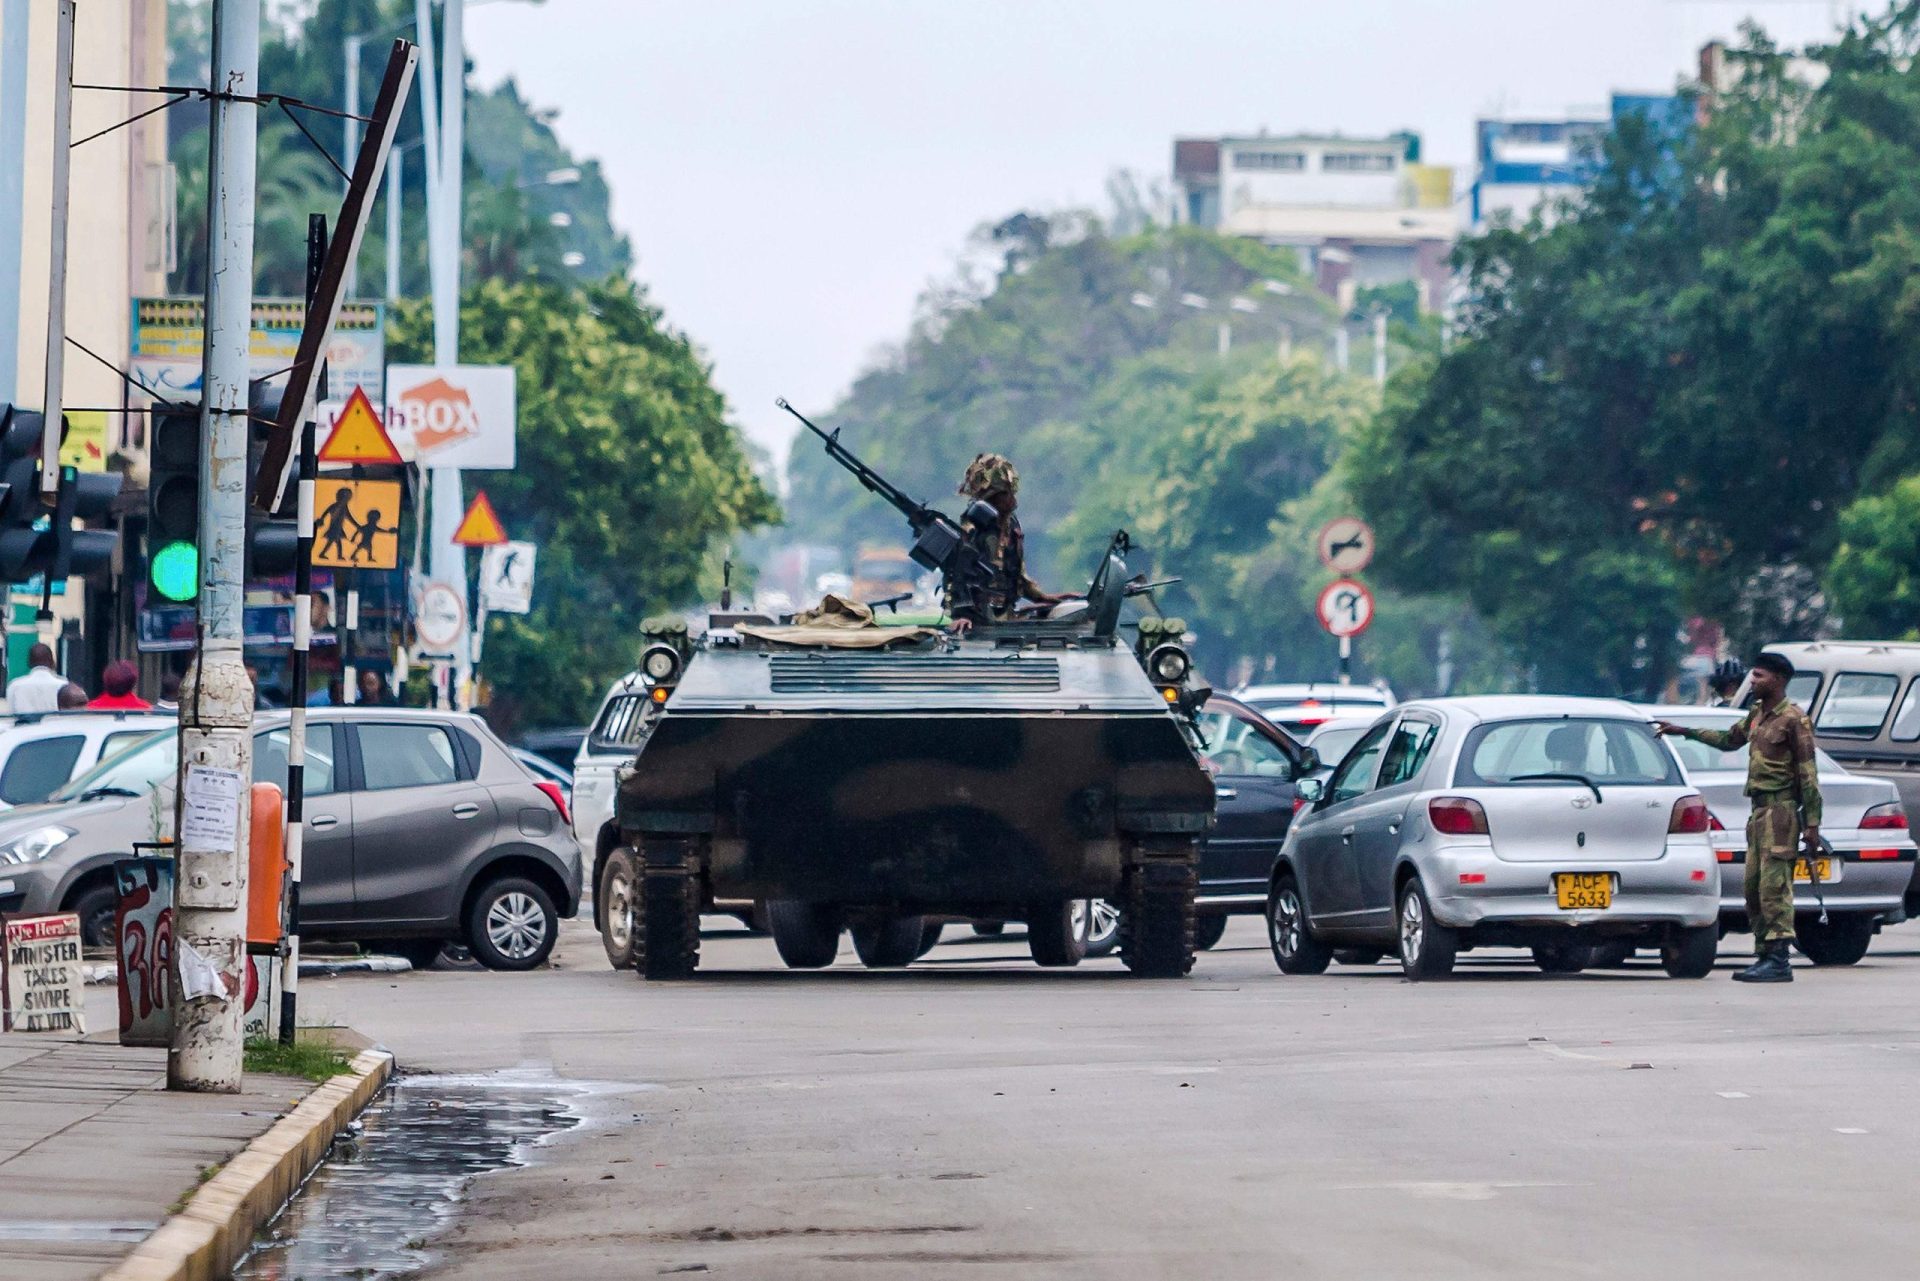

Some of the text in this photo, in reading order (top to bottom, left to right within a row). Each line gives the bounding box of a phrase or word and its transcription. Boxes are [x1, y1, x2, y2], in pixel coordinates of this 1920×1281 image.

[1573, 875, 1603, 889] ACF
[1568, 891, 1606, 906] 5633
[34, 918, 79, 938] Hera
[11, 942, 78, 966] MINISTER
[24, 967, 68, 988] TAKES
[24, 989, 71, 1010] SWIPE
[27, 1012, 72, 1032] AT VID
